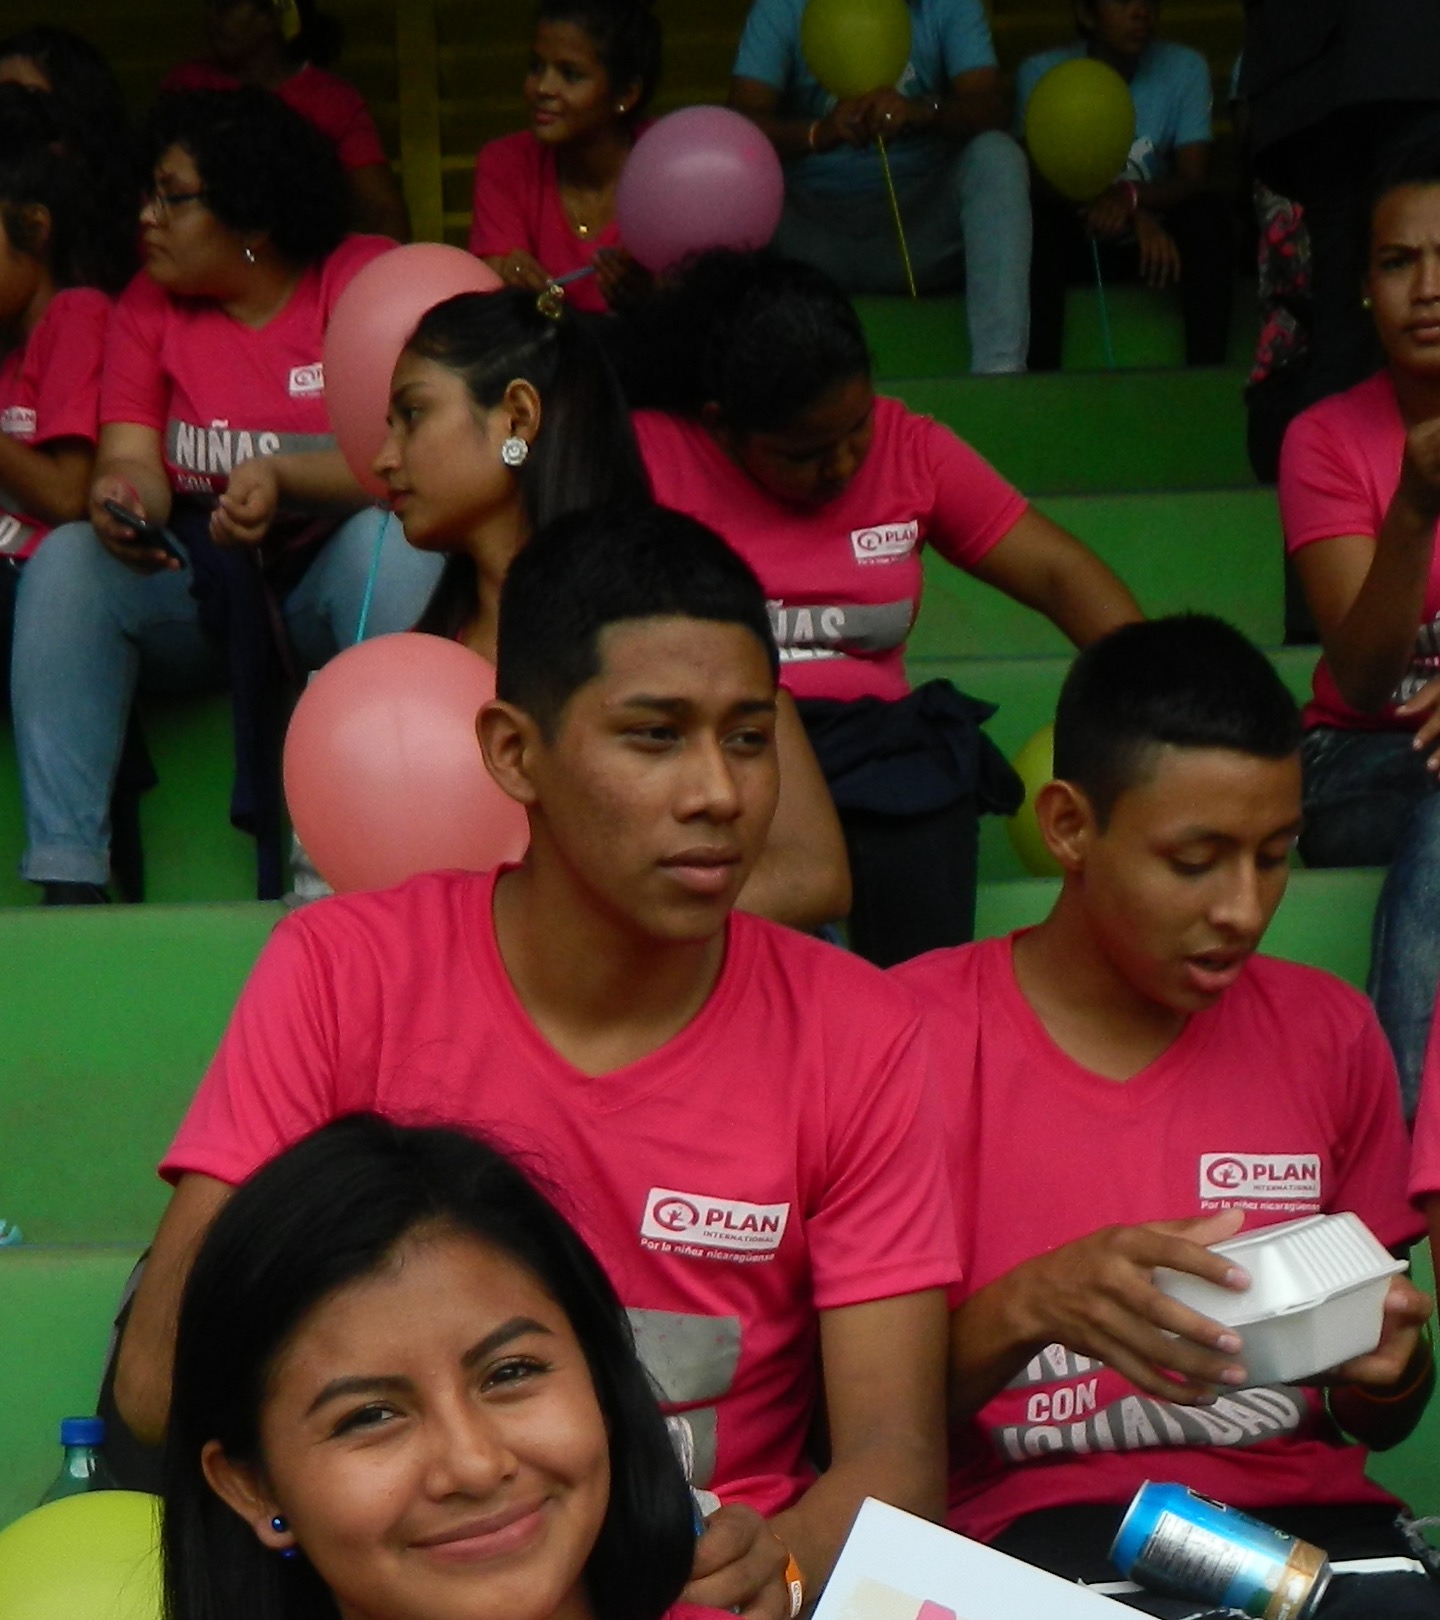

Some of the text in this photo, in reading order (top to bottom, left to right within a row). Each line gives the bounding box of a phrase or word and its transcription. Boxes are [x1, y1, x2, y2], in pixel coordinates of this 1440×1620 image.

[176, 418, 281, 473] NIÑAS
[1253, 1163, 1317, 1181] PLAN
[1201, 1200, 1219, 1210] Por
[1221, 1199, 1231, 1209] la
[705, 1208, 781, 1233] PLAN
[640, 1237, 776, 1264] Por la niñez nicaragüense
[1027, 1378, 1098, 1423] CON
